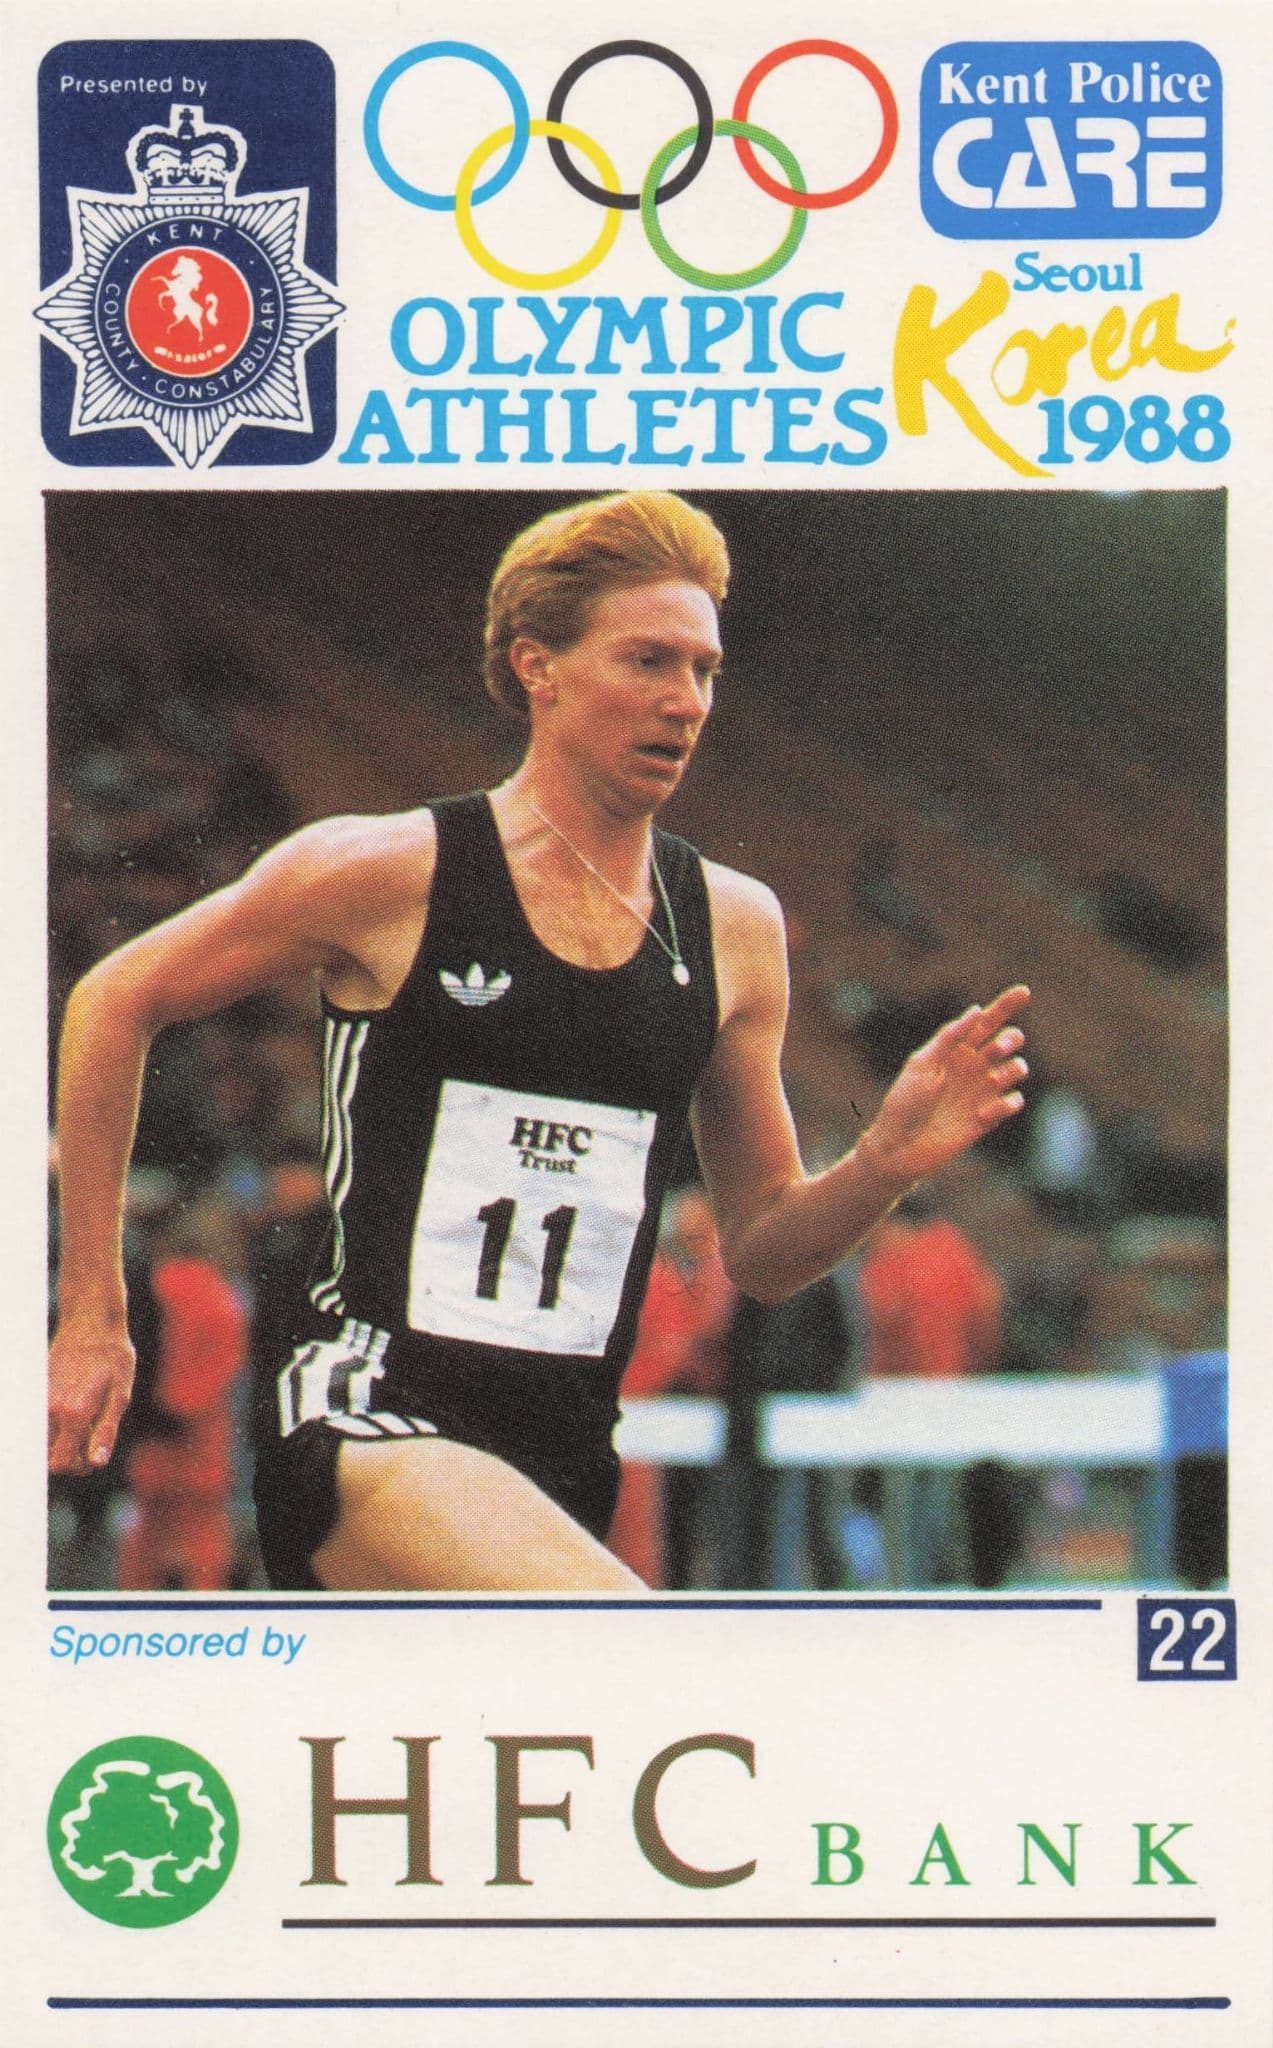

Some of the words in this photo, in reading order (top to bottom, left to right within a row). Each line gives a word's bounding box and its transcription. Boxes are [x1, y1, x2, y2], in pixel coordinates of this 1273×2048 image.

[60, 75, 173, 94] Presented
[182, 75, 208, 97] by
[938, 62, 1048, 104] Kent
[1069, 61, 1212, 104] Police
[933, 117, 1206, 208] CARE
[146, 222, 224, 247] KENT
[1013, 252, 1143, 292] Seoul
[103, 283, 140, 372] COUNTY
[154, 286, 276, 400] CONSTABULARY
[390, 291, 846, 377] OLYMPIC
[893, 270, 1237, 478] Korea
[338, 386, 888, 467] ATHLETES
[1037, 394, 1231, 464] 1988
[509, 1116, 593, 1156] HFC
[518, 1149, 577, 1174] Trust
[475, 1196, 578, 1310] 11
[49, 1625, 249, 1664] Sponsored
[261, 1626, 306, 1664] by
[1149, 1608, 1227, 1671] 22
[298, 1733, 757, 1889] HFC
[810, 1821, 1198, 1887] BANK
